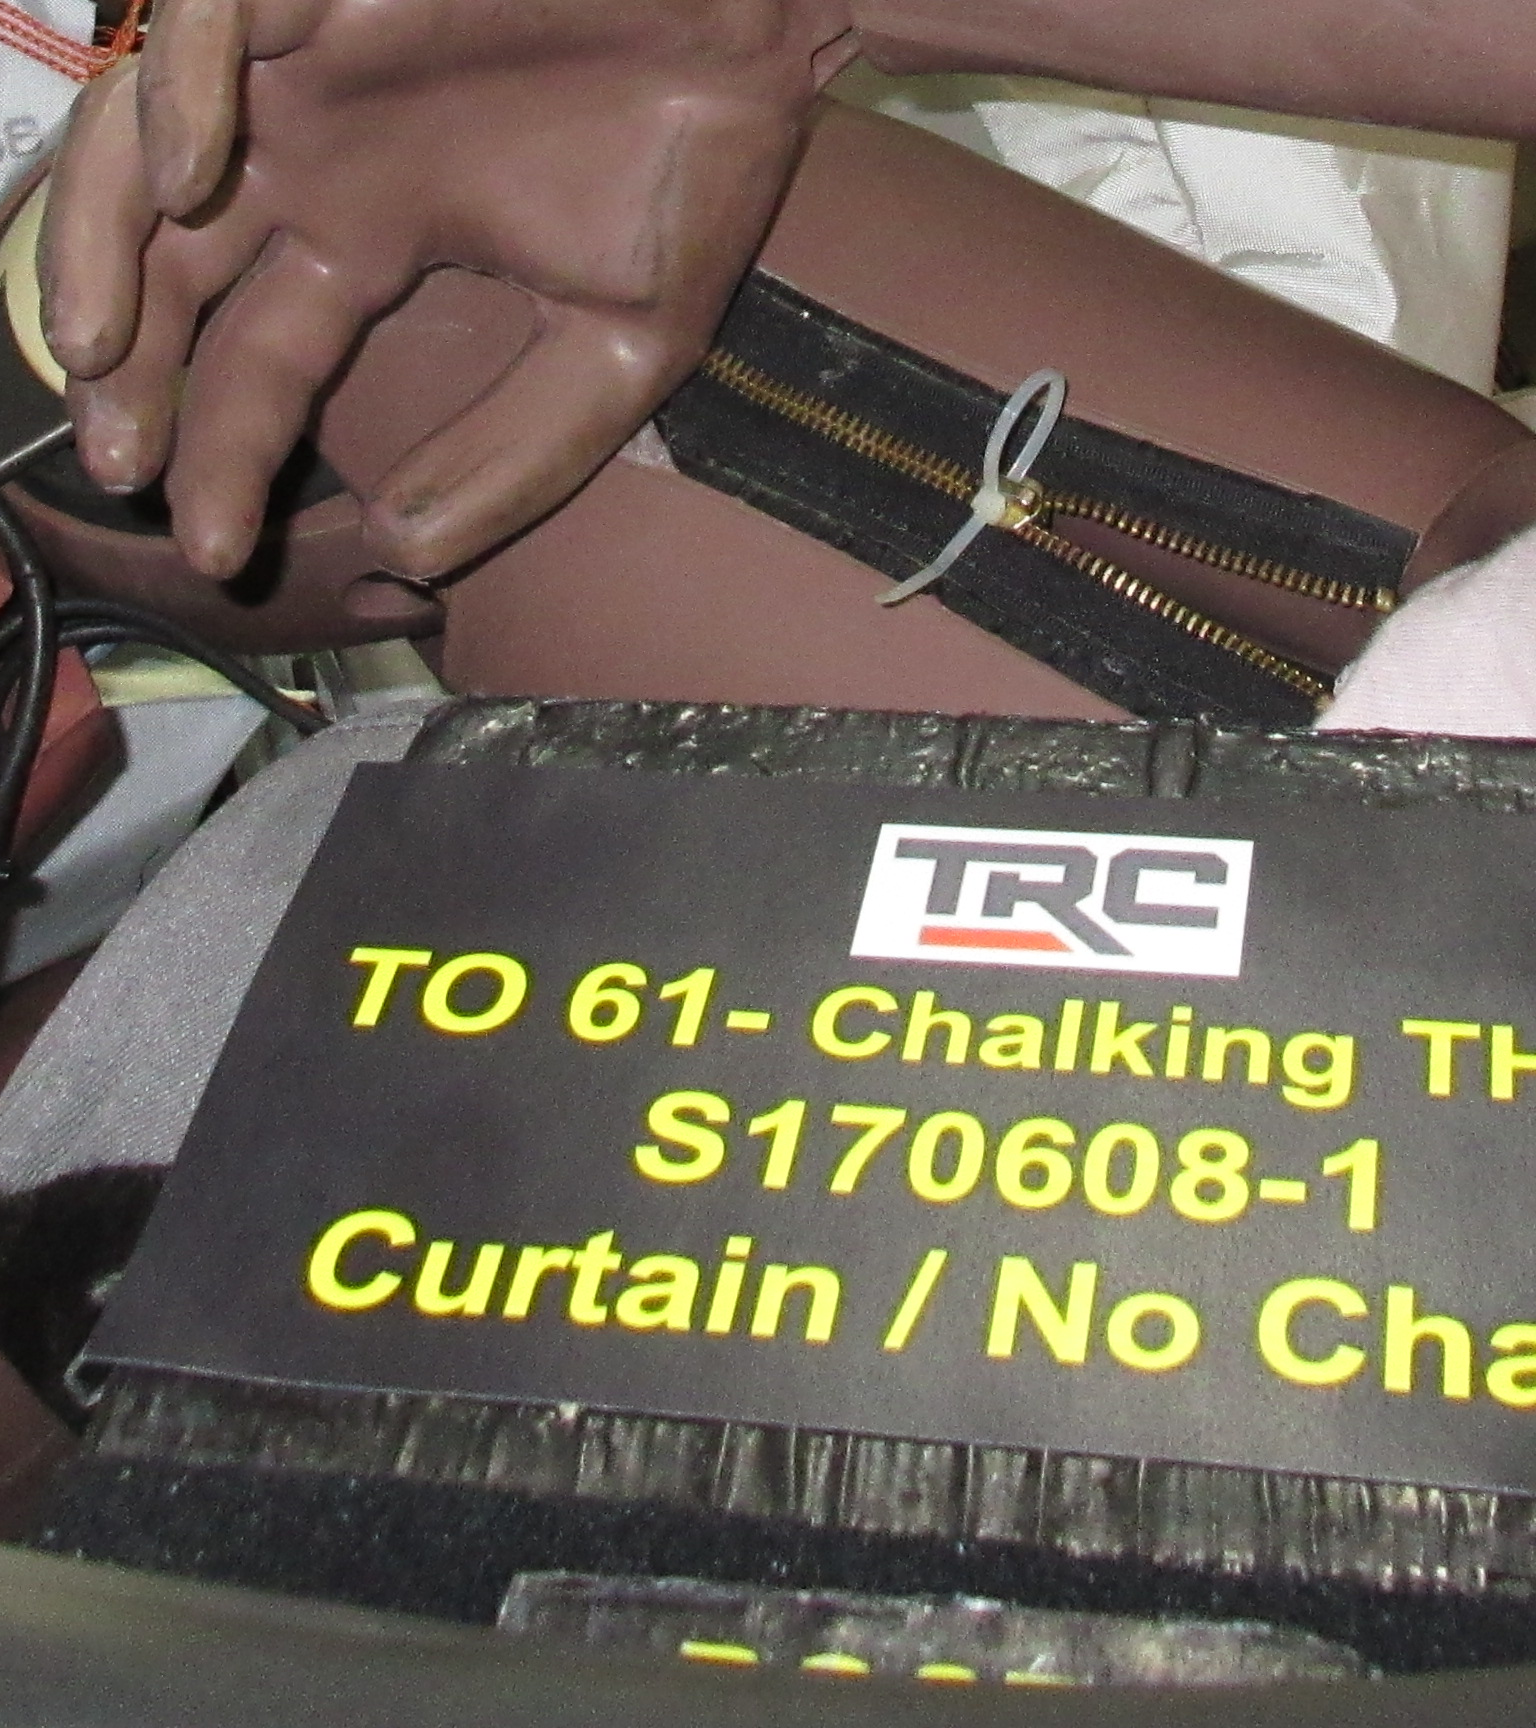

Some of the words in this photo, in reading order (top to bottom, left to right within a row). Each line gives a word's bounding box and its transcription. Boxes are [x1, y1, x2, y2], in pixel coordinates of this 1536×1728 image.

[894, 837, 1230, 957] TRC
[348, 945, 529, 1038] TO
[566, 960, 773, 1050] 61-
[805, 982, 1361, 1114] Chalking
[631, 1087, 1387, 1230] S170608-1
[305, 1207, 847, 1343] Curtain
[878, 1249, 952, 1354] /
[982, 1256, 1206, 1374] No
